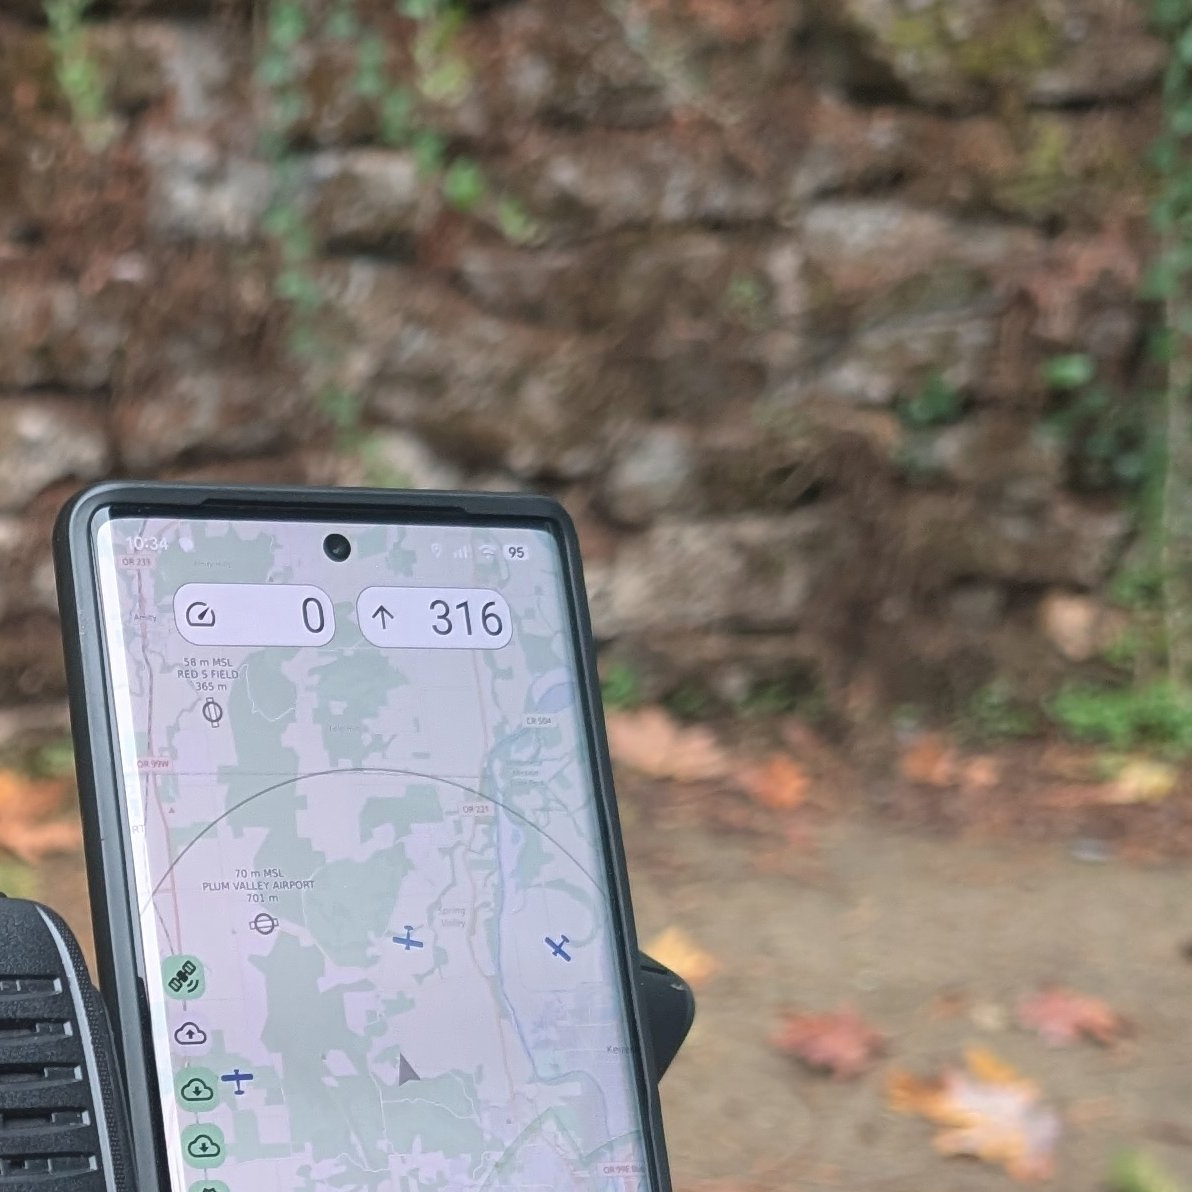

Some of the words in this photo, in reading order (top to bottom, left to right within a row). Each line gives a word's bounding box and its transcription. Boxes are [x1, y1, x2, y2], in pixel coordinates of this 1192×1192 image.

[126, 536, 169, 551] 10:34
[508, 546, 525, 559] 95
[302, 597, 325, 634] 0
[429, 599, 504, 637] 316
[183, 657, 197, 667] 58
[199, 659, 210, 667] m
[212, 657, 233, 668] MSL
[177, 669, 199, 679] RED
[211, 669, 239, 680] FIELD
[195, 681, 215, 692] 365
[217, 683, 227, 692] m
[234, 868, 247, 878] 70
[263, 868, 284, 878] MSL
[202, 881, 230, 891] PLUM
[232, 880, 270, 891] VALLEY
[272, 879, 315, 890] AIRPORT
[246, 893, 265, 903] 701
[268, 895, 279, 903] m
